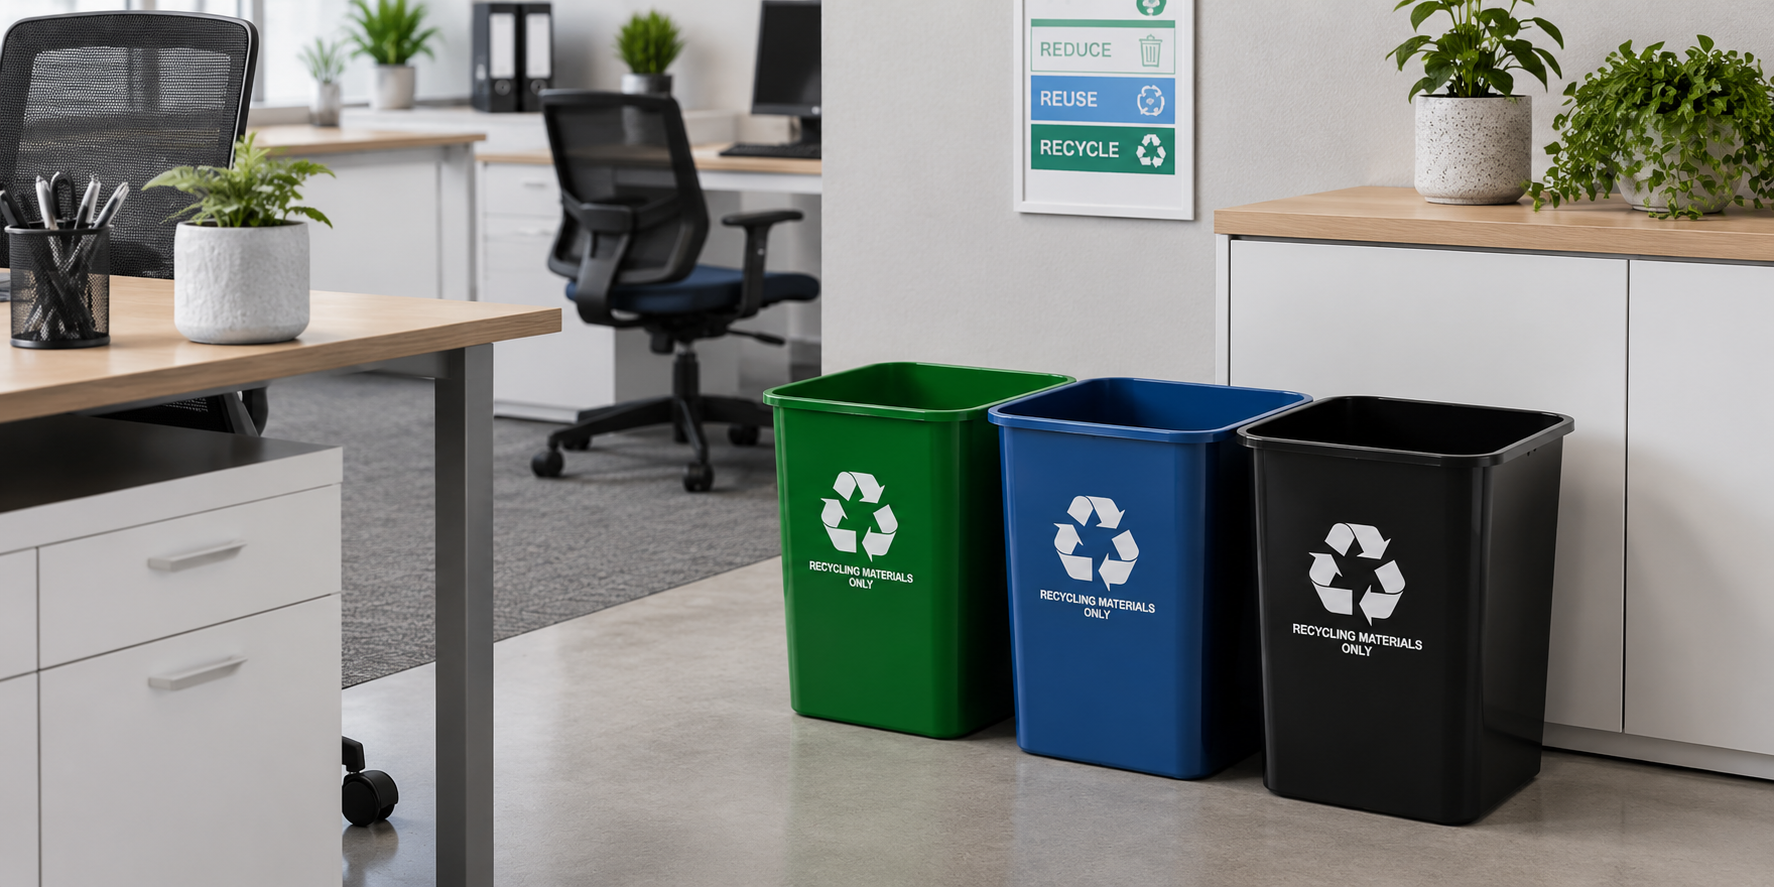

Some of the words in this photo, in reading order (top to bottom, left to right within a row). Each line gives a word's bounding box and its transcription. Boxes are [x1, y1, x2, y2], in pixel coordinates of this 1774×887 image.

[1040, 42, 1112, 57] REDUCE
[1040, 91, 1098, 107] REUSE
[1040, 140, 1119, 158] RECYCLE
[809, 560, 860, 576] RECYCLING
[862, 568, 914, 583] MATERIALS
[848, 577, 873, 589] ONLY
[1040, 589, 1096, 606] RECYCLING
[1098, 597, 1156, 613] MATERIALS
[1083, 608, 1111, 619] ONLY
[1292, 623, 1356, 641] RECYCLING
[1358, 632, 1423, 650] MATERIALS
[1341, 643, 1372, 656] ONLY
